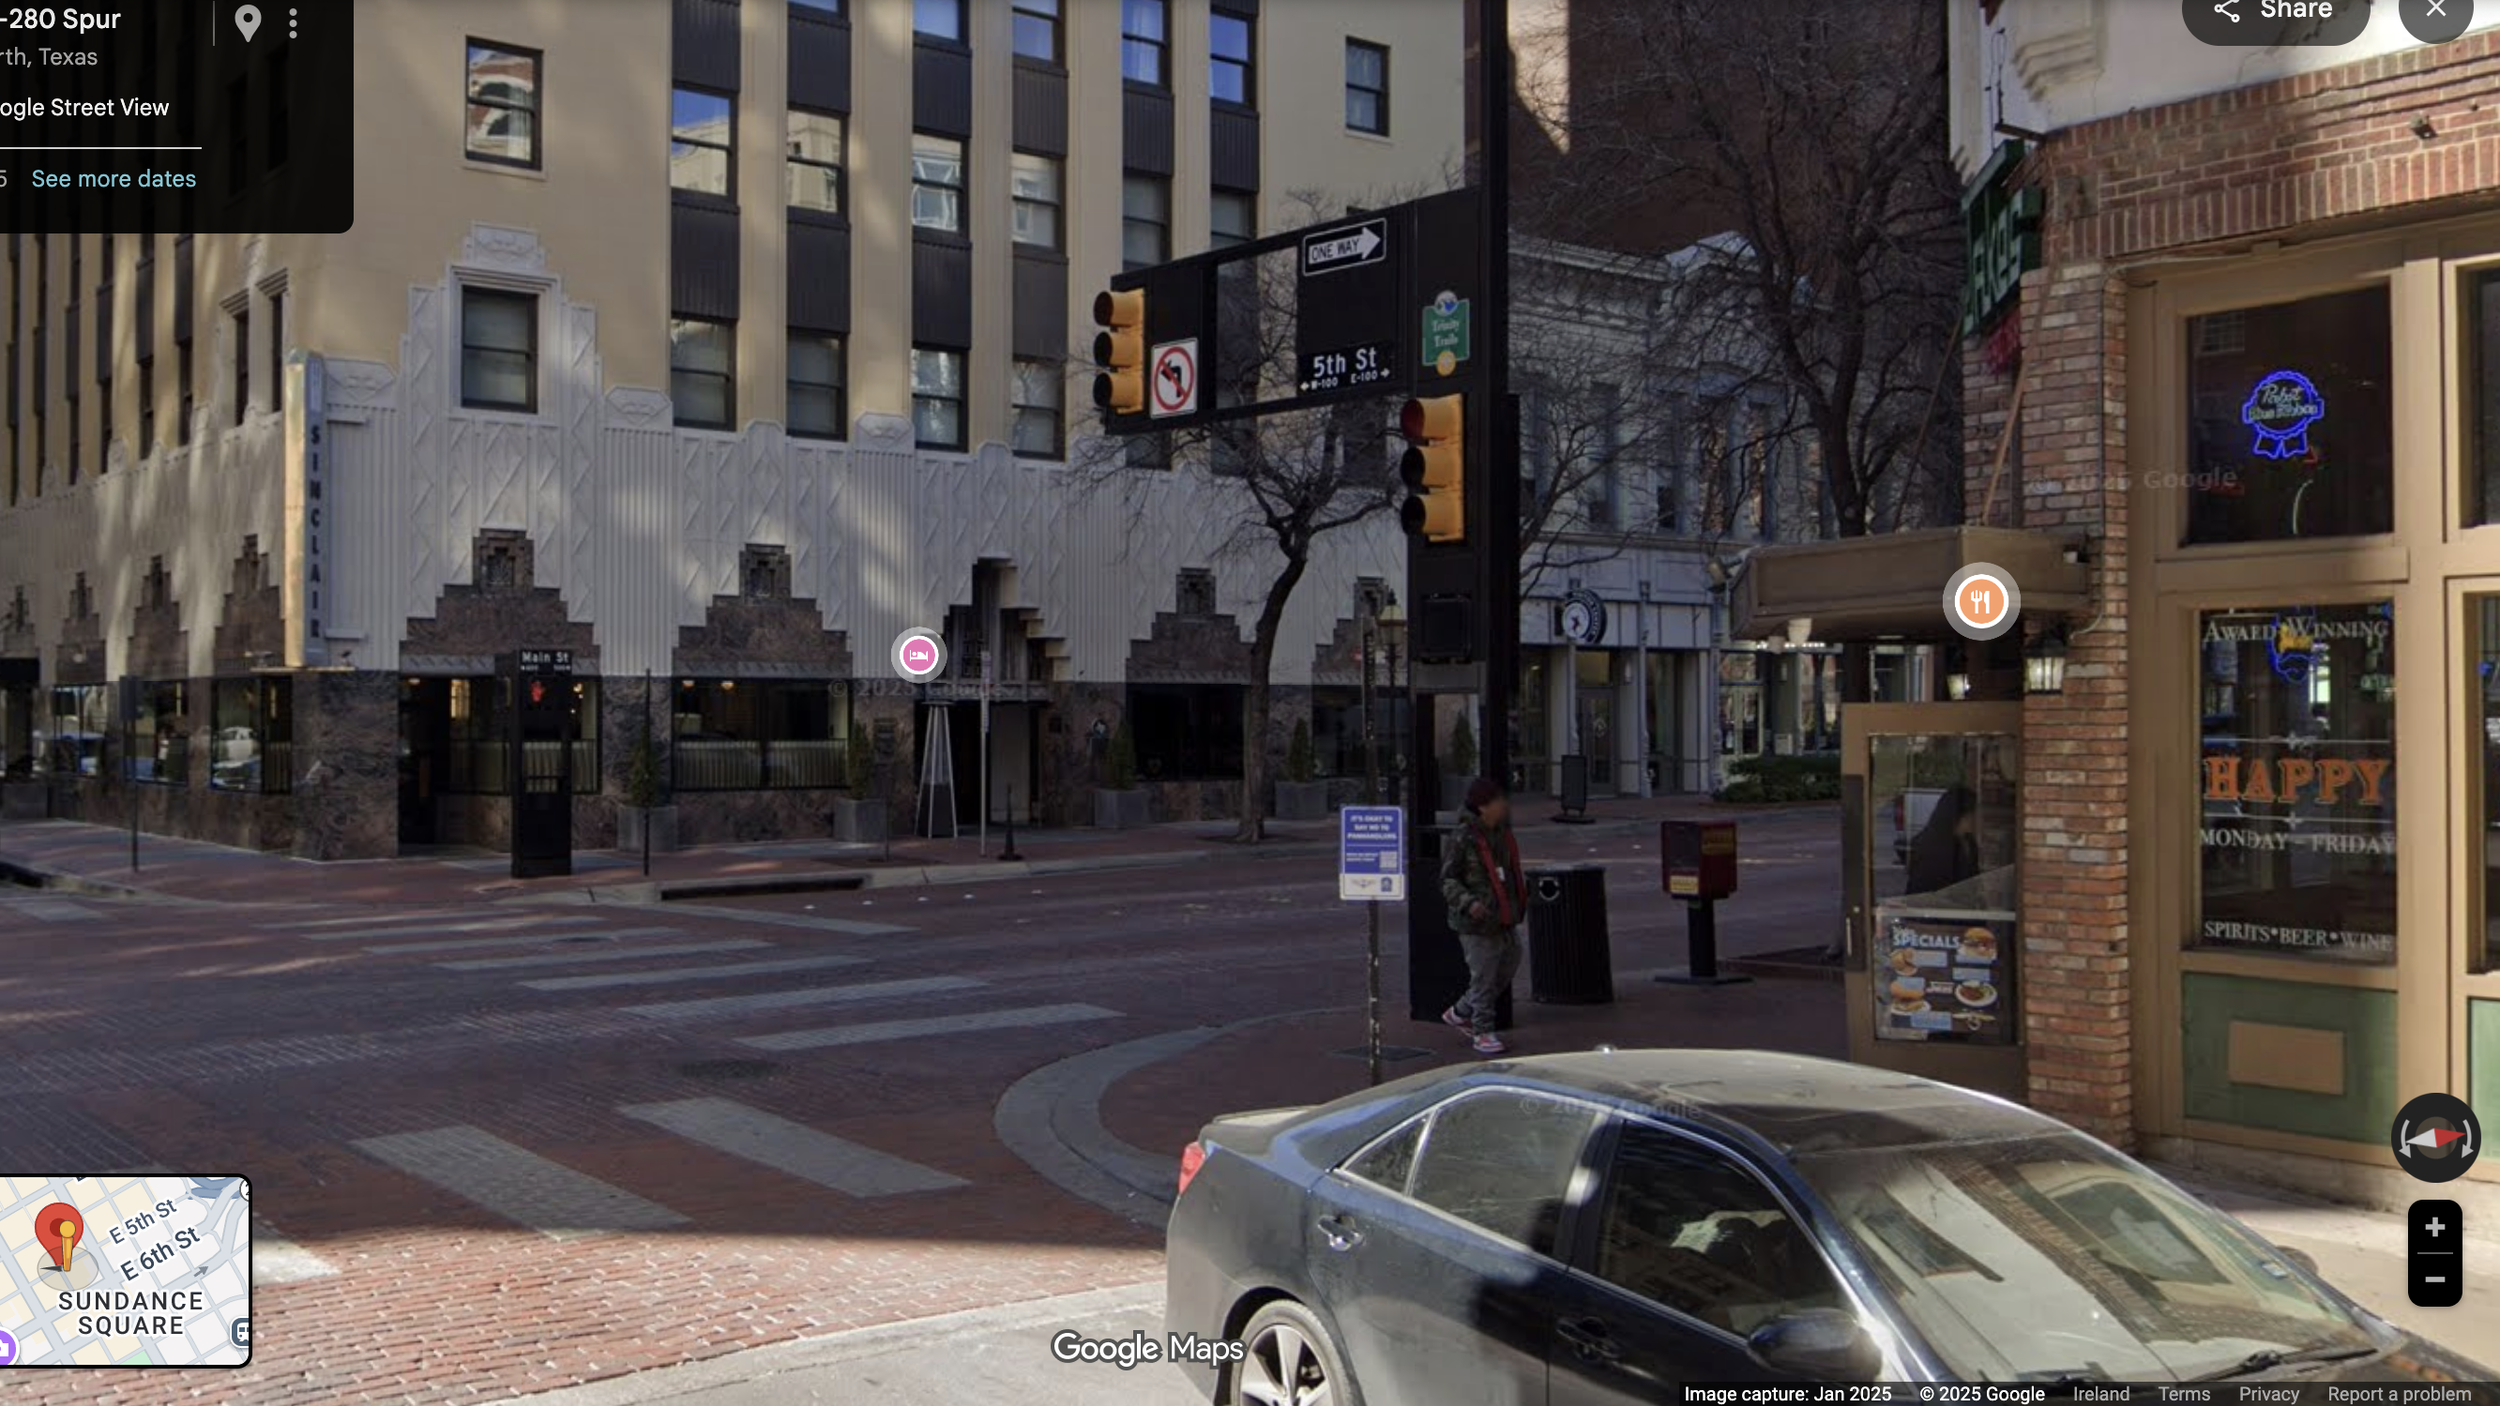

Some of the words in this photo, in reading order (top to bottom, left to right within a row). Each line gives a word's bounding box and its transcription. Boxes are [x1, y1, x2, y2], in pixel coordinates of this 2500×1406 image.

[1312, 243, 1334, 261] ONE
[1337, 238, 1361, 255] WAY
[1313, 352, 1347, 378] 5th
[1355, 346, 1378, 371] St
[1350, 369, 1378, 384] E-100
[2261, 383, 2304, 404] Pabst
[309, 425, 321, 638] SINCLAIR
[2286, 616, 2389, 639] WINNING
[522, 651, 551, 663] Main
[556, 651, 569, 663] St
[2204, 756, 2391, 805] HAPPY
[2200, 828, 2289, 852] MONDAY
[2312, 835, 2397, 855] FRIDAY
[1893, 934, 1960, 949] SPECIALS
